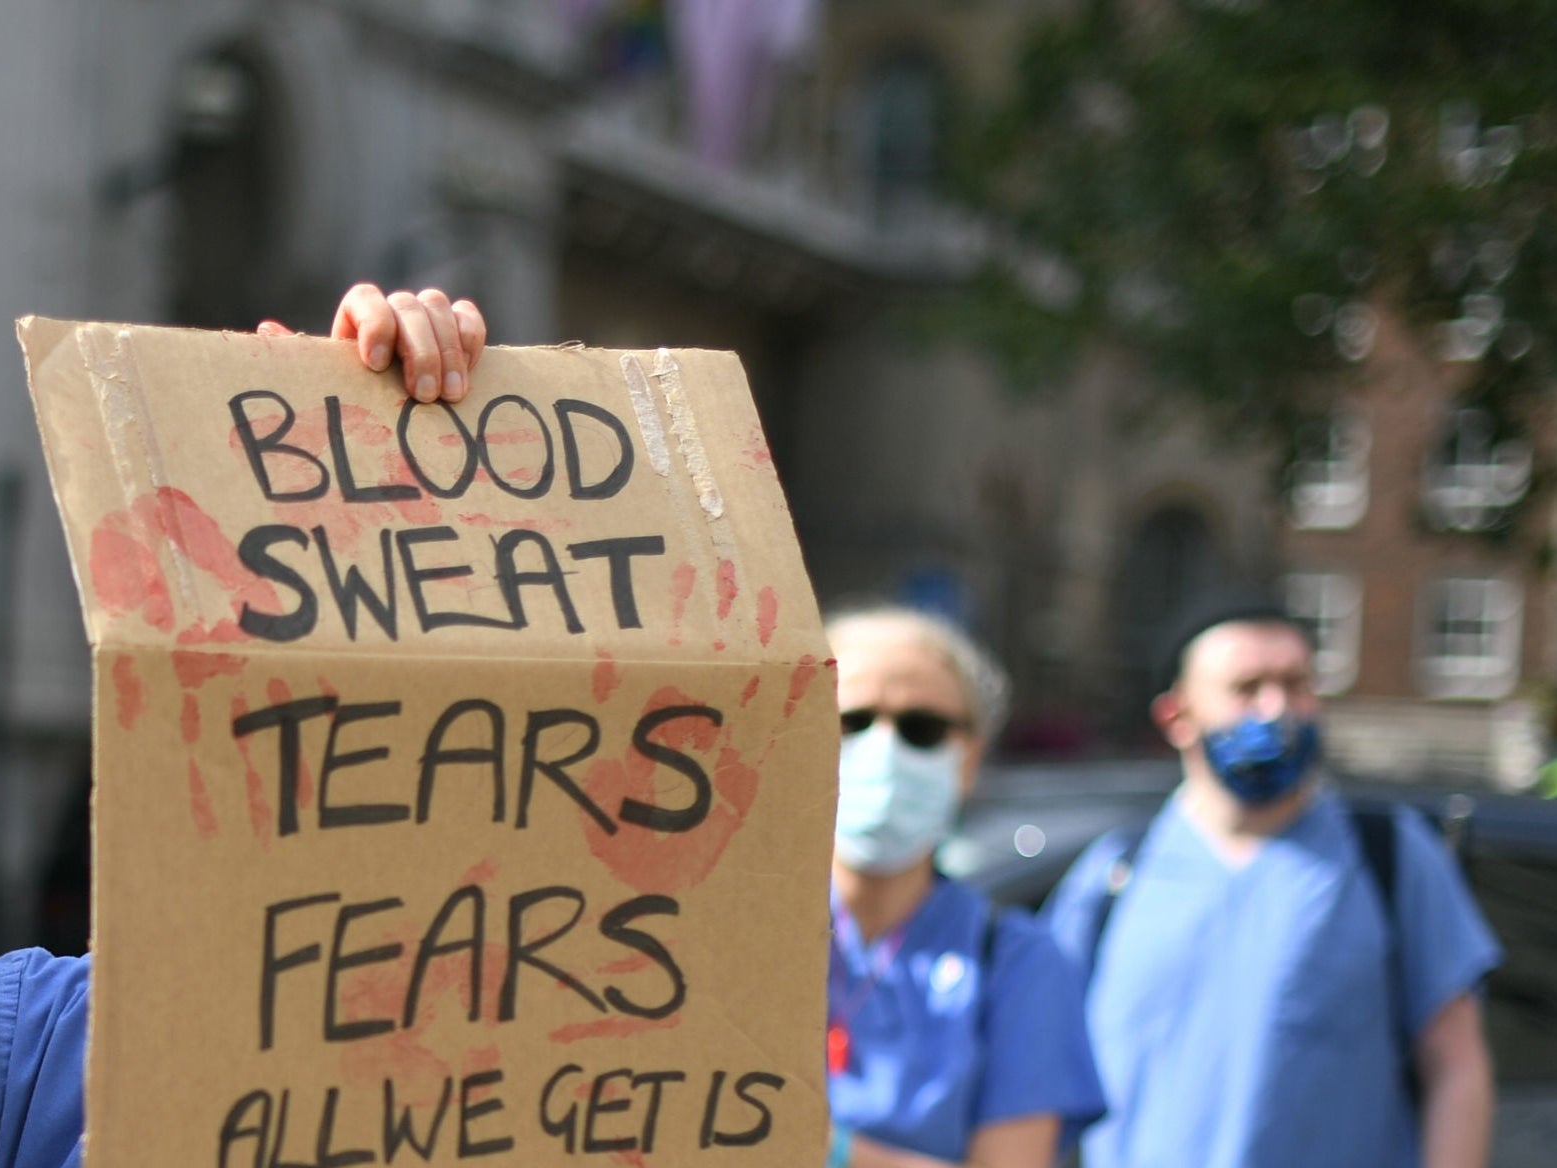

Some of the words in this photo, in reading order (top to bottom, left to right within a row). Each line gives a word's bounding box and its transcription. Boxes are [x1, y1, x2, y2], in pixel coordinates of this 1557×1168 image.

[227, 390, 635, 502] BLOOD
[237, 524, 665, 643] SWEAT
[233, 696, 723, 836] TEARS
[259, 884, 687, 1051] FEARS
[383, 1069, 514, 1165] WE
[540, 1064, 686, 1155] GET
[699, 1070, 786, 1149] IS
